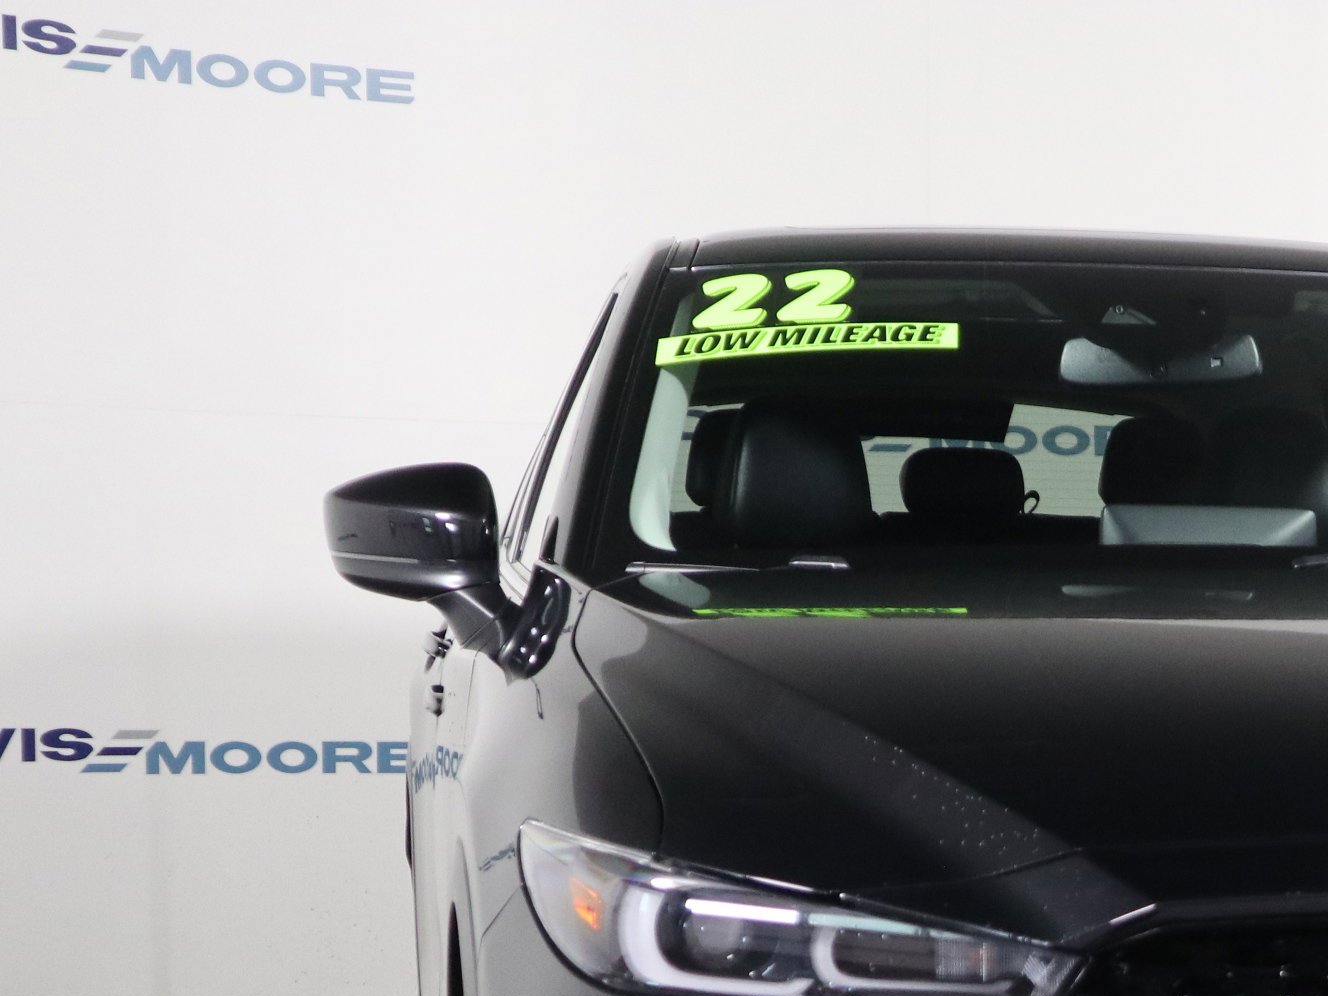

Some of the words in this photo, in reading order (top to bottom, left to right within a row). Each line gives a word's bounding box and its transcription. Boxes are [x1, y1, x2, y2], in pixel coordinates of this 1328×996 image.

[130, 45, 416, 104] MOORE
[691, 268, 856, 332] 22
[674, 329, 762, 359] LOW
[768, 323, 944, 349] MILEAGE
[144, 740, 409, 775] MOORE
